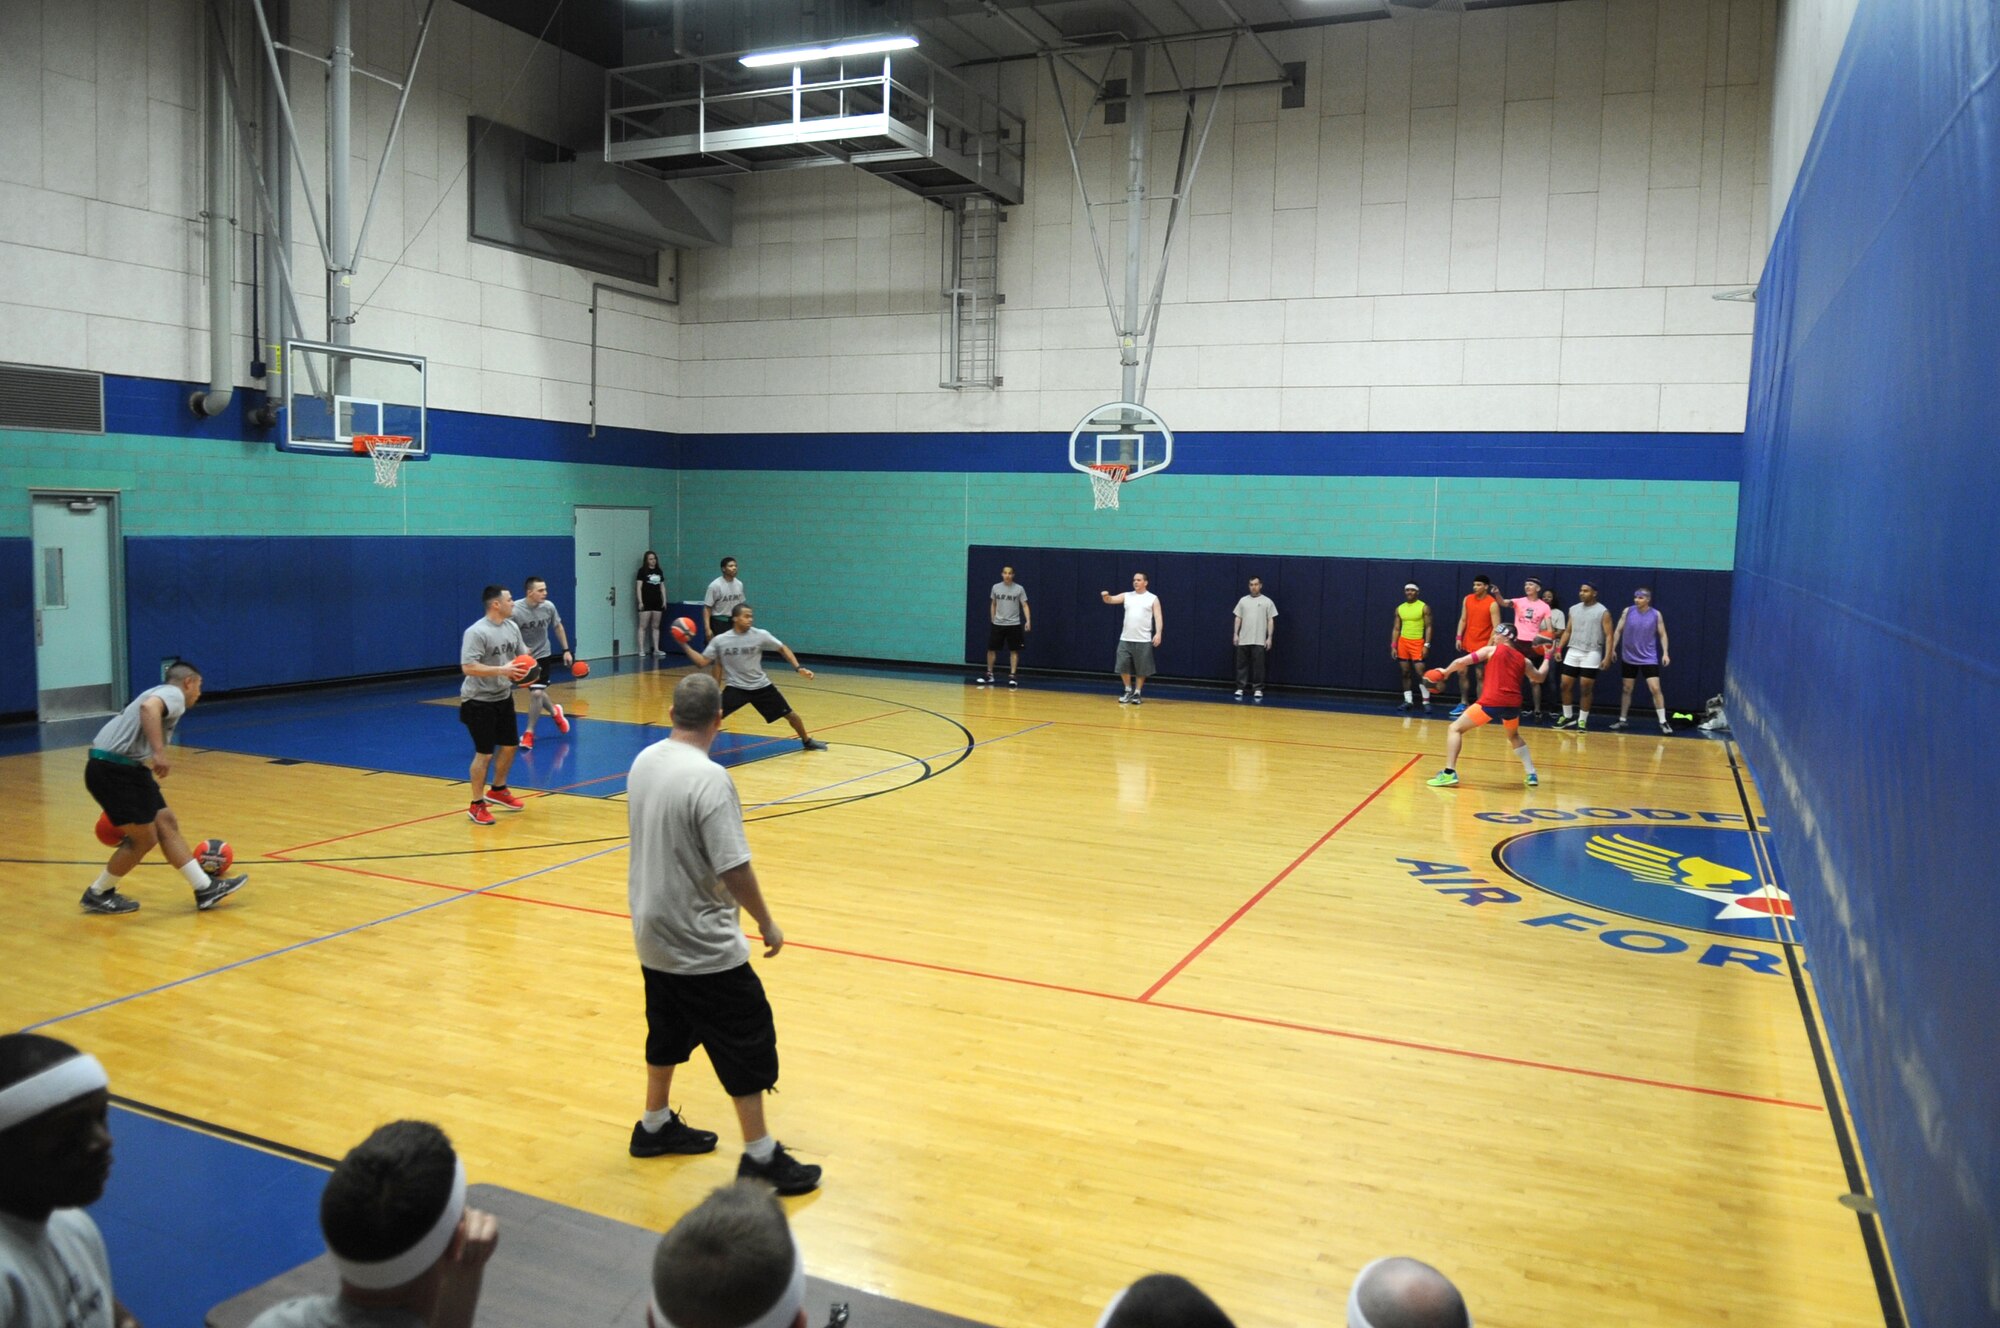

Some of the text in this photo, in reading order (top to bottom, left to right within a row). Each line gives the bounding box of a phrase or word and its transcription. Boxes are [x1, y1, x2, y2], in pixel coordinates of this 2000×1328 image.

[1473, 807, 1768, 827] GOODF
[1395, 857, 1808, 977] AIR FOR
